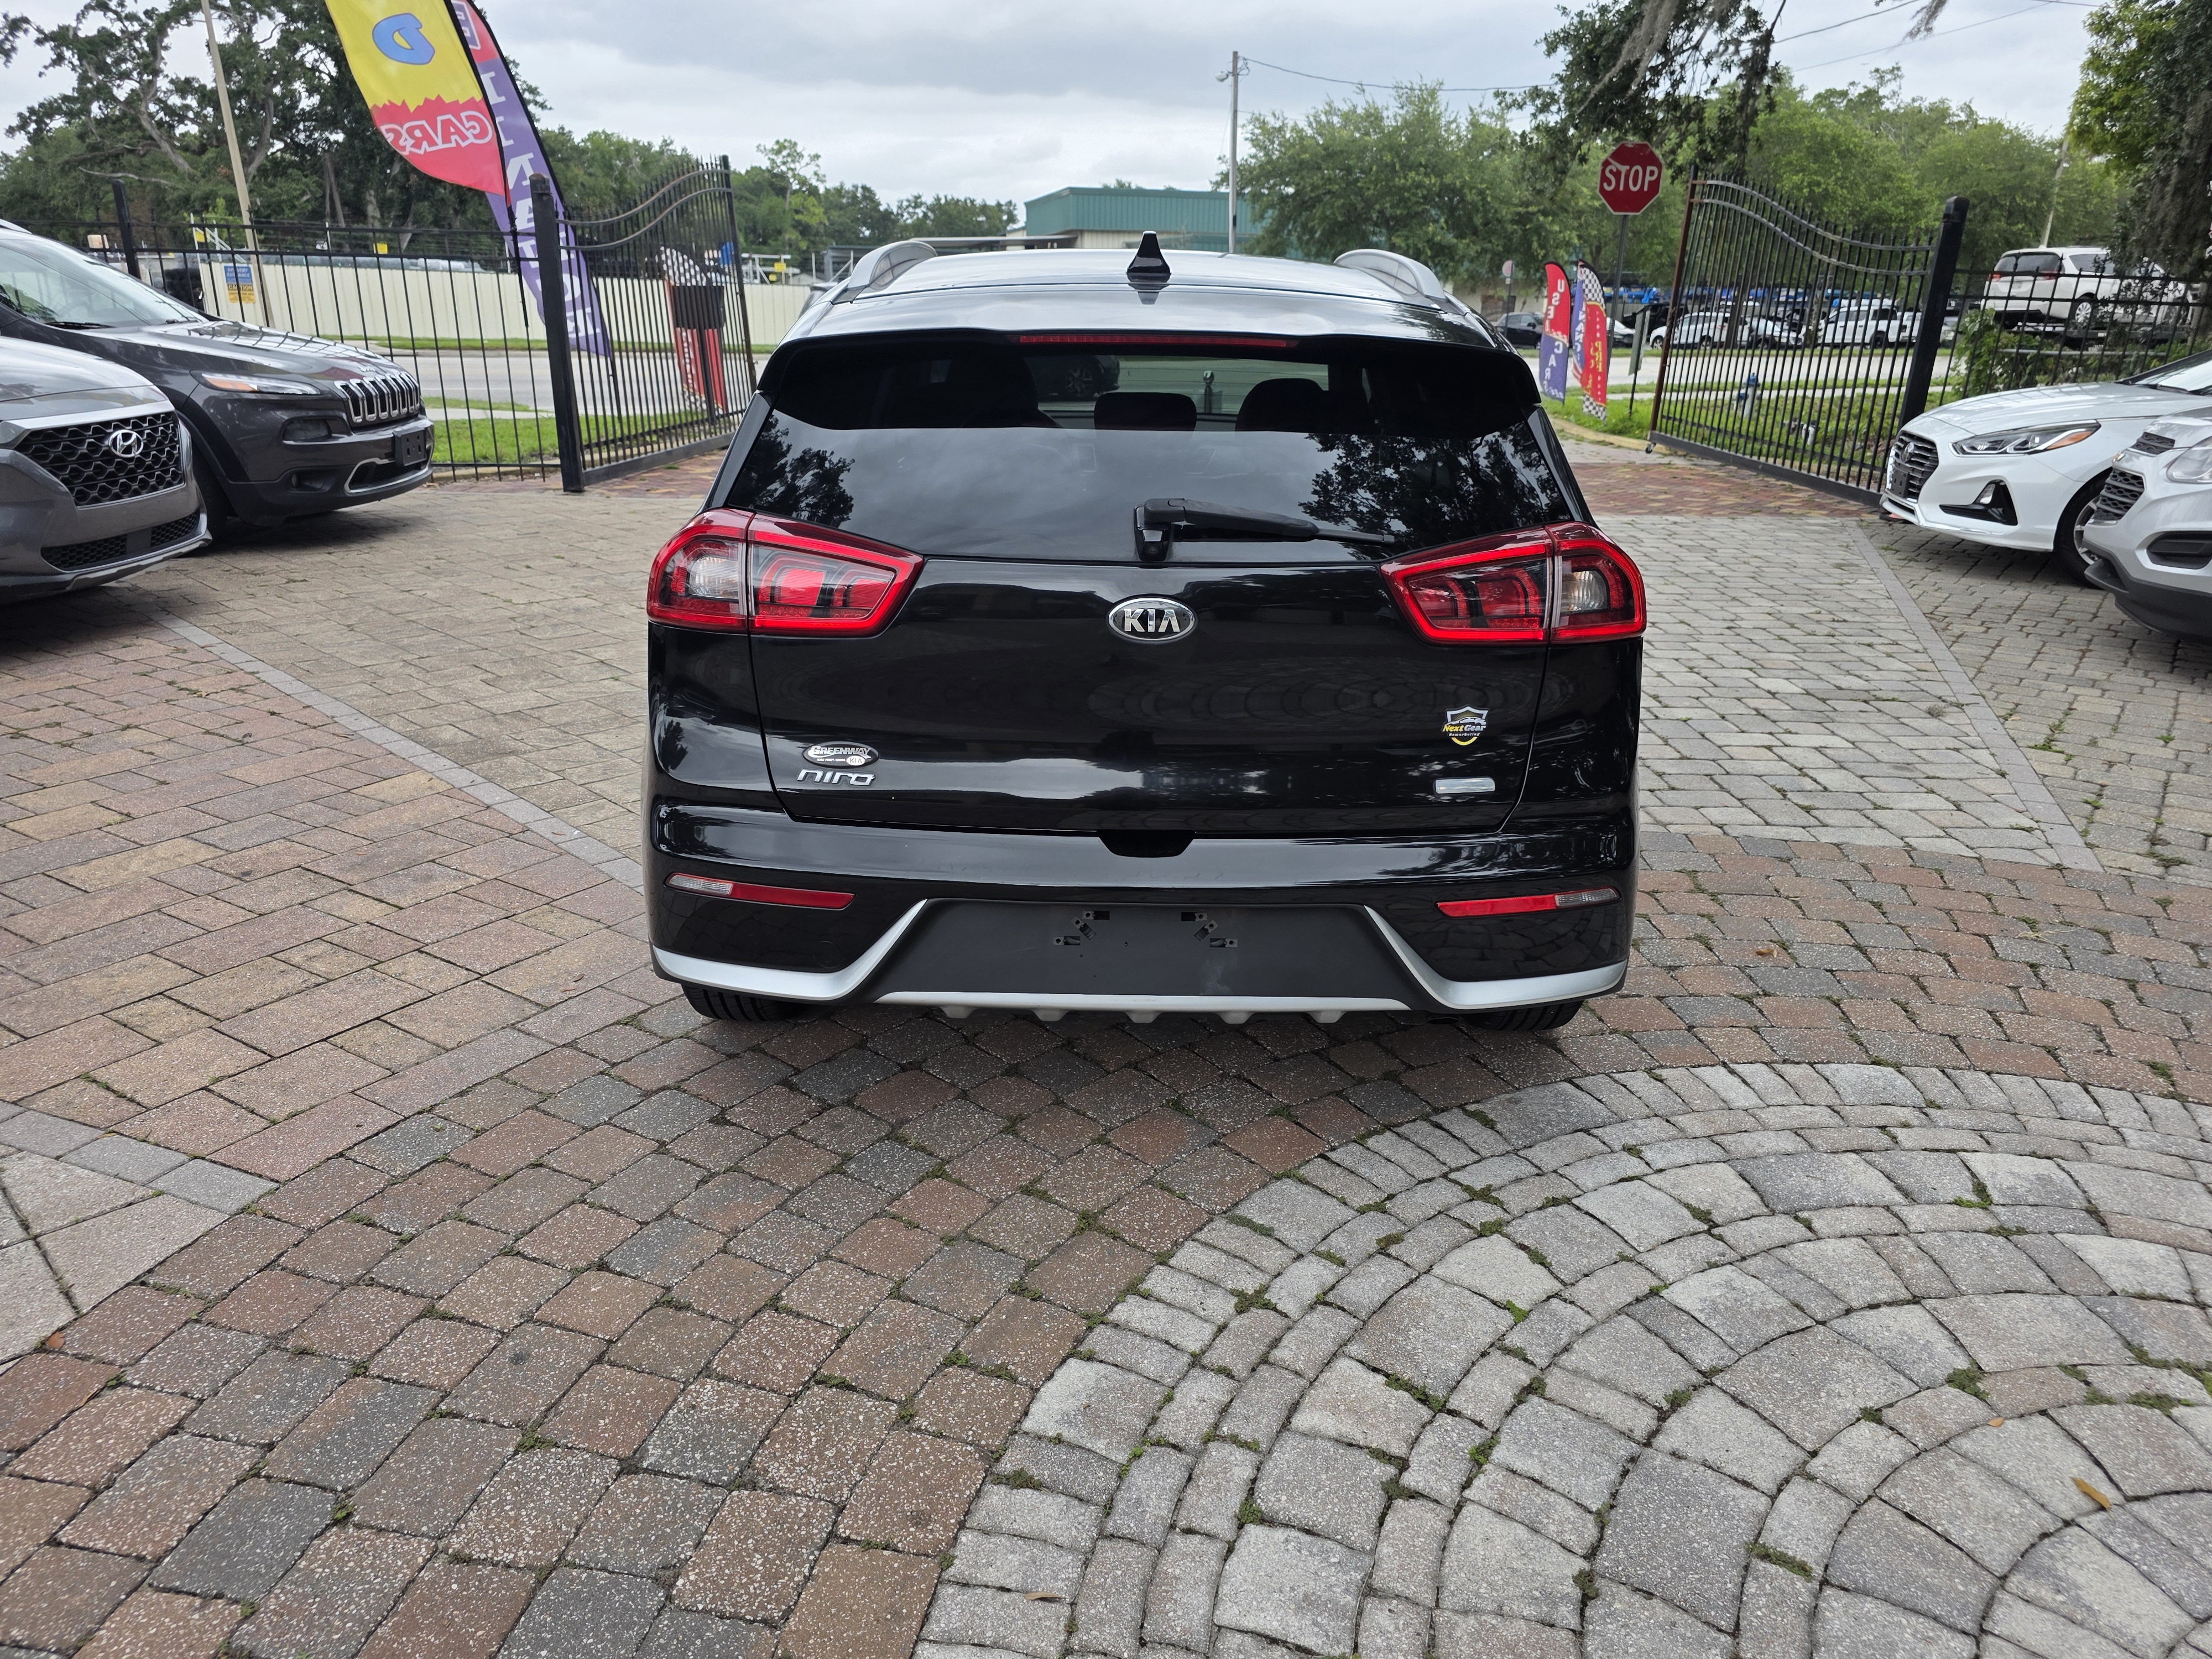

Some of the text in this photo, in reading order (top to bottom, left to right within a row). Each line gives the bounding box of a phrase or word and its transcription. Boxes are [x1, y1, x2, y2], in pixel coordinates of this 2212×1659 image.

[1603, 165, 1658, 192] STOP
[1123, 608, 1180, 633] KIA
[1442, 724, 1464, 732] Next
[808, 745, 872, 758] GREENWAY
